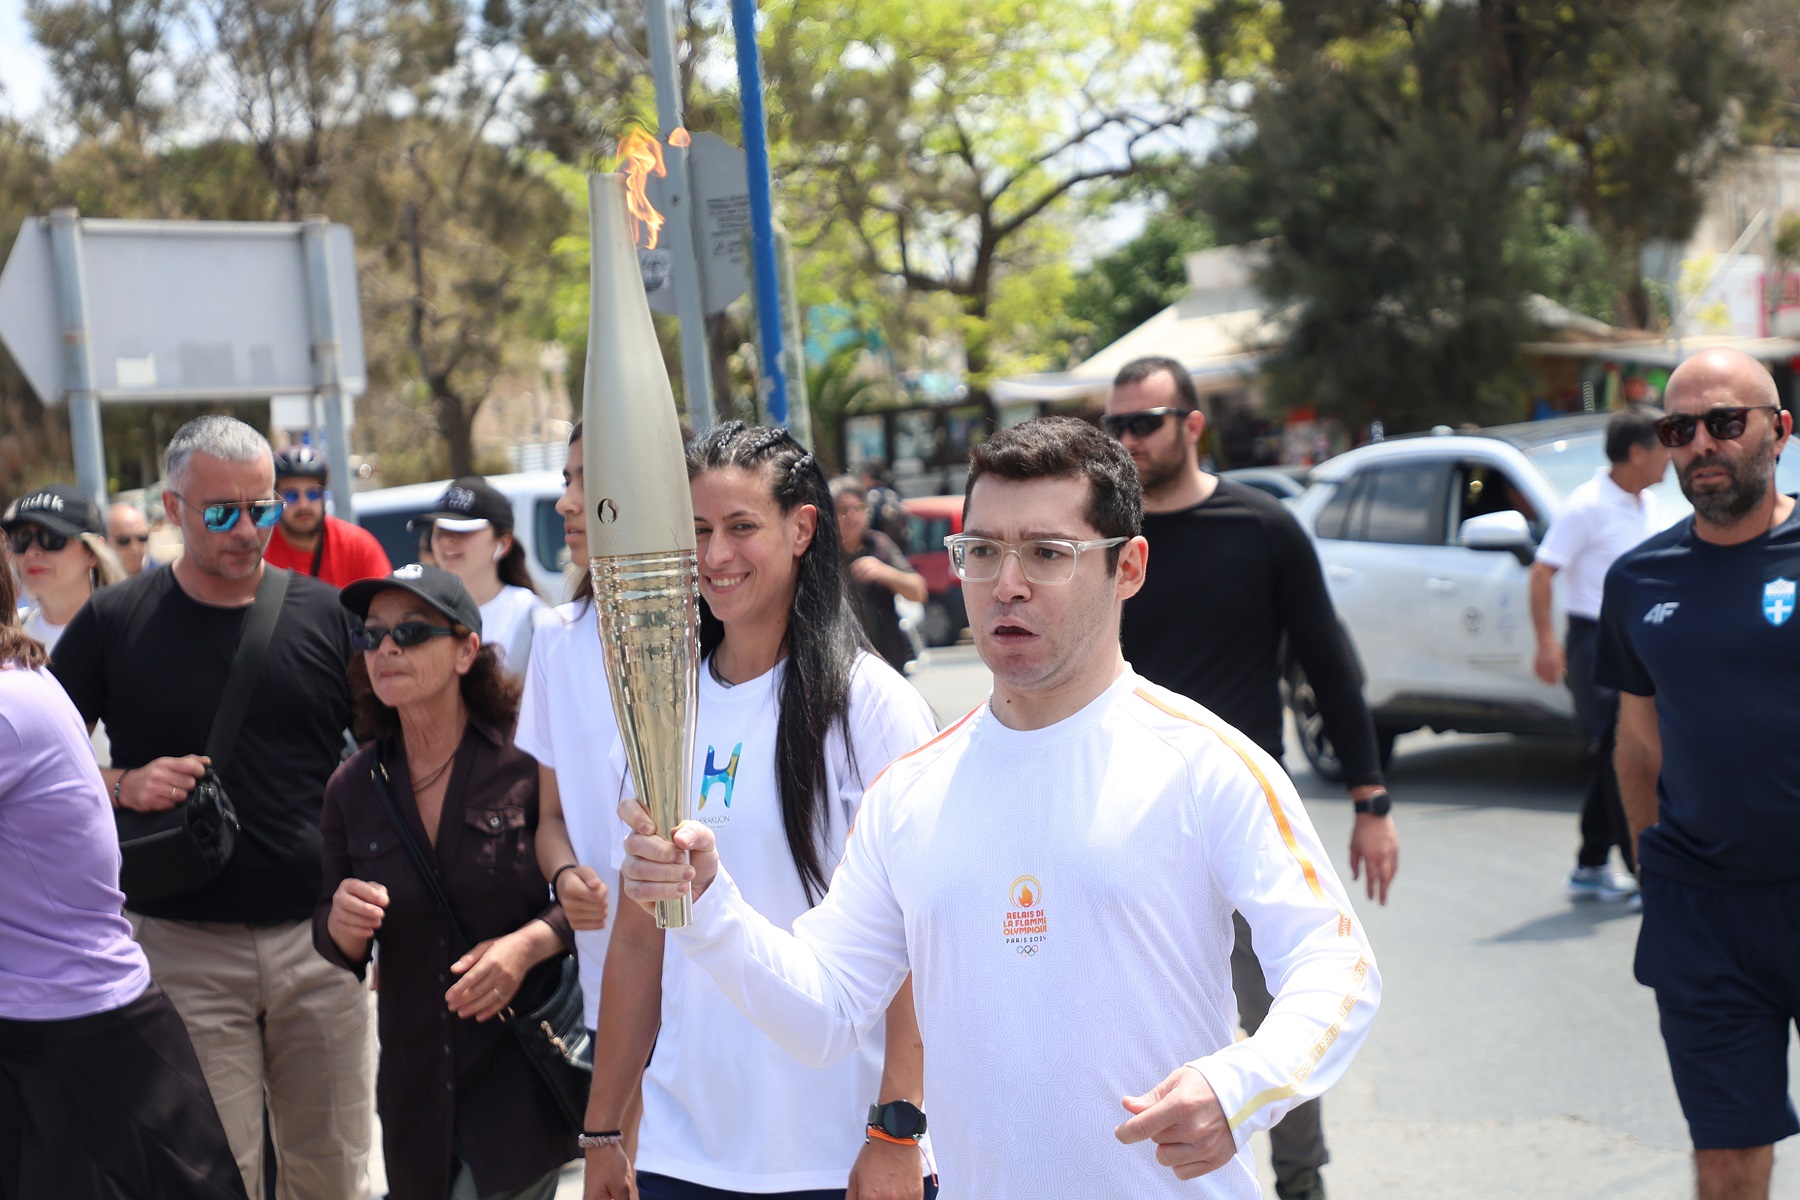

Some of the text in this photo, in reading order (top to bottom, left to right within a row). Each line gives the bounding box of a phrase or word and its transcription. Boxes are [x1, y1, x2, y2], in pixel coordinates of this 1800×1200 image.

[1006, 911, 1034, 919] RELAIS
[1015, 917, 1046, 926] FLAMME
[1003, 925, 1047, 935] OLYMPIQUE
